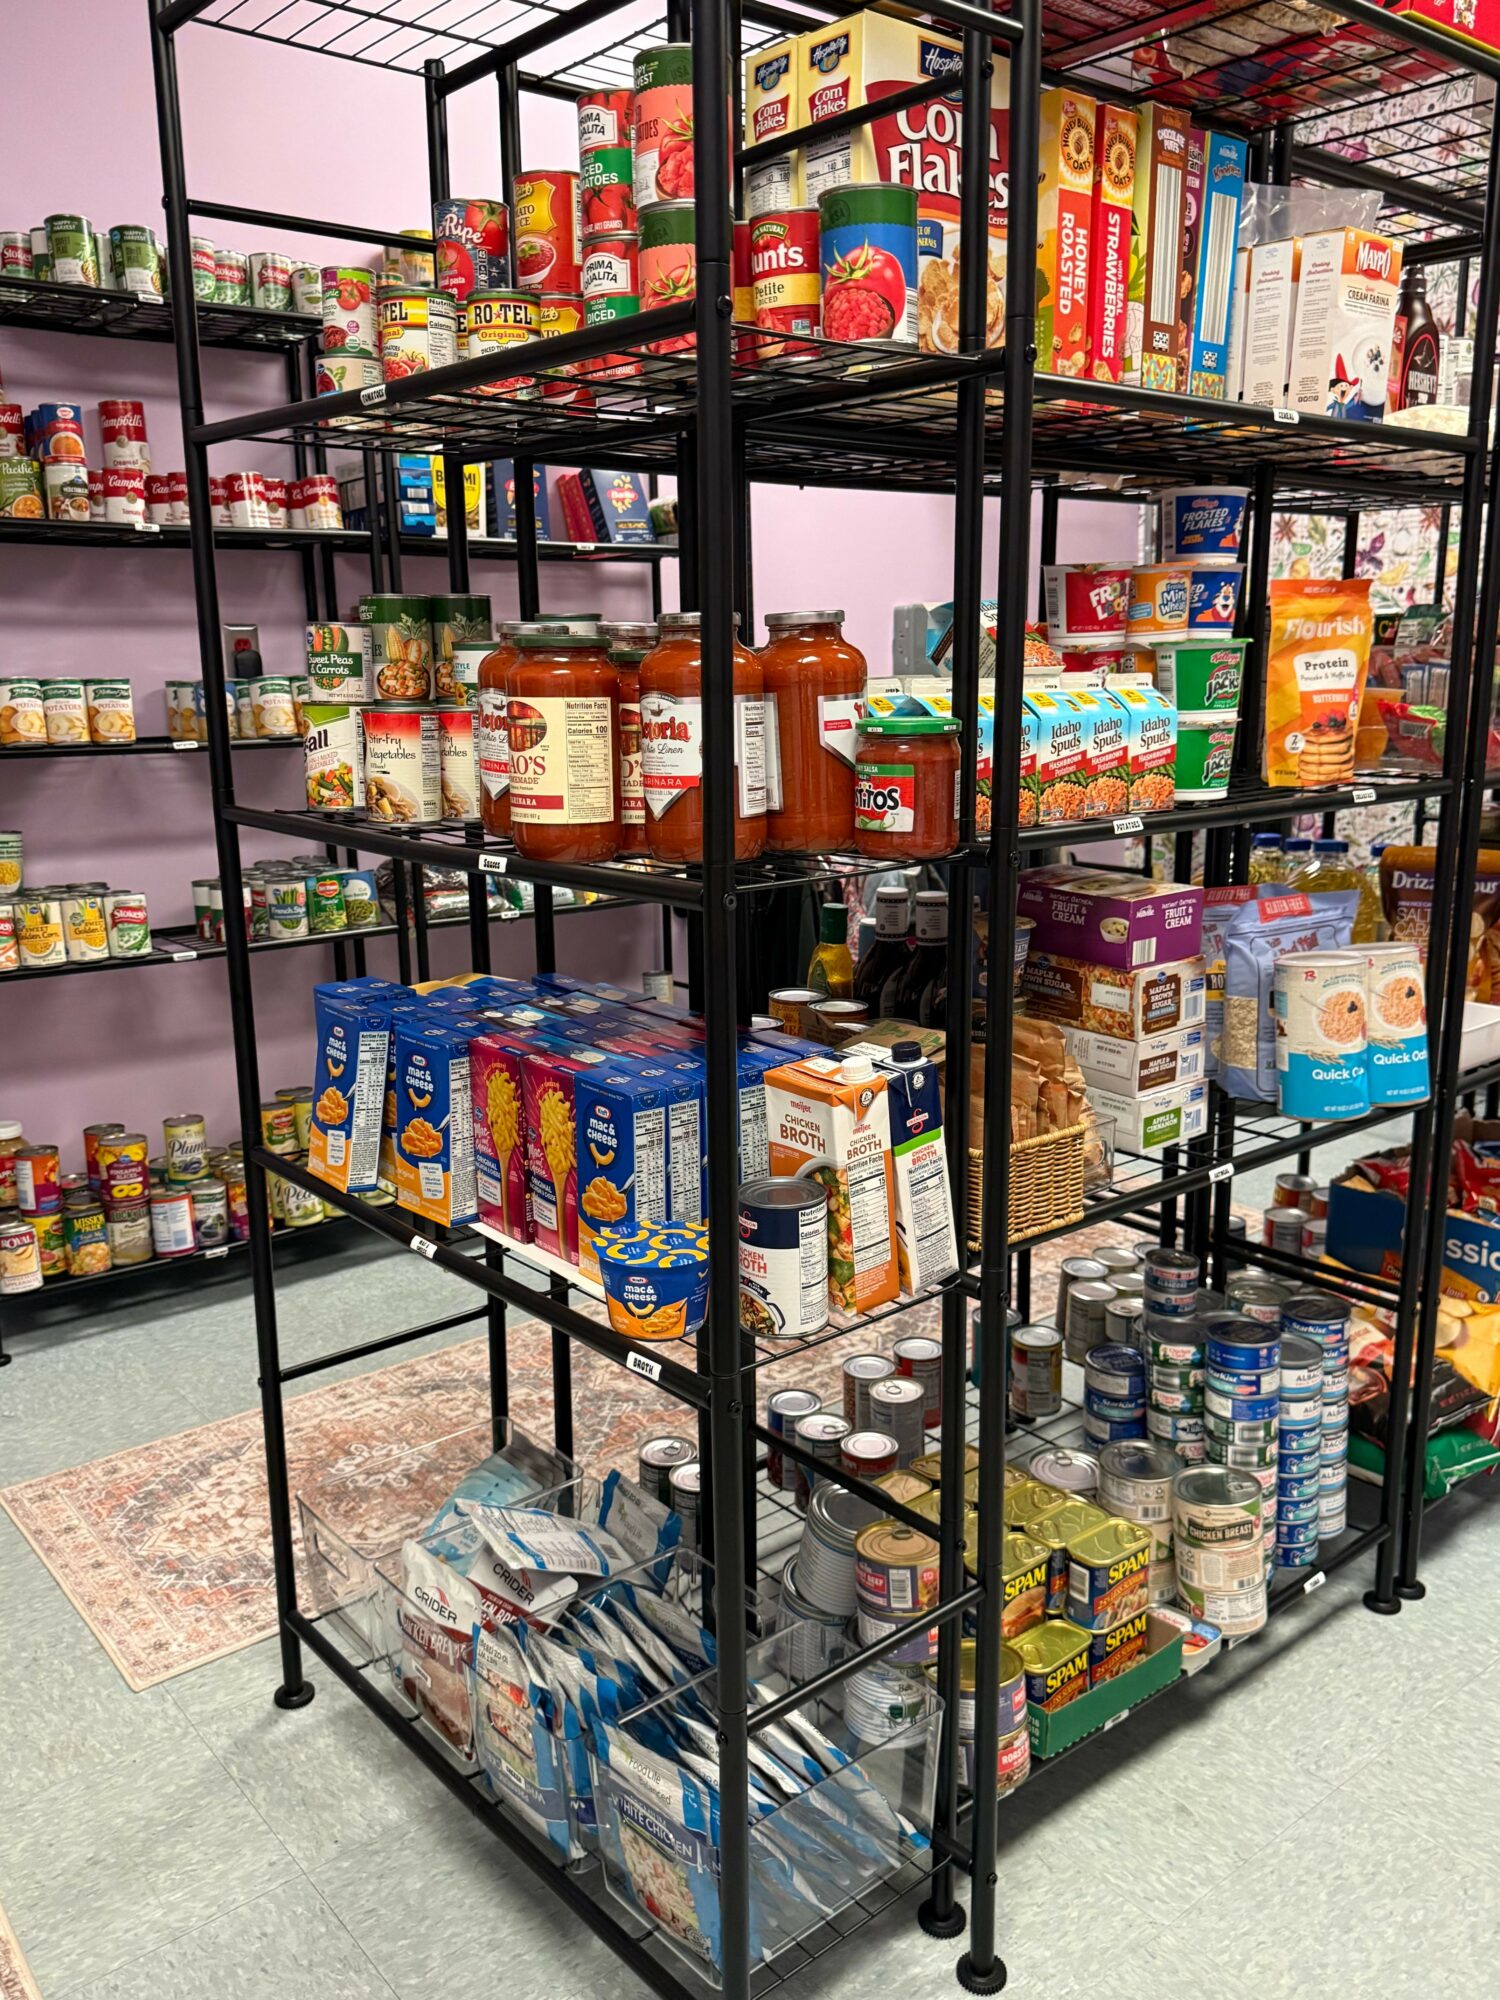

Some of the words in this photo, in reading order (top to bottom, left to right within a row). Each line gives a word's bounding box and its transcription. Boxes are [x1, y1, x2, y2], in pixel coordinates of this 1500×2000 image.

[925, 48, 962, 75] Hospita
[815, 87, 842, 105] Corn
[758, 103, 781, 121] Corn
[813, 98, 846, 122] Flakes
[756, 115, 785, 136] Flakes
[1063, 119, 1076, 147] HONEY
[1077, 119, 1093, 153] BUNCHES
[1158, 129, 1185, 148] CHOCOLATE
[1106, 136, 1117, 162] HONEY
[1119, 135, 1134, 169] BUNCHES
[1073, 160, 1090, 170] OATS
[1114, 175, 1130, 185] OATS
[445, 214, 483, 243] Ripe
[586, 261, 612, 274] PRIMA
[1060, 213, 1074, 315] ROASTED
[1075, 228, 1088, 305] HONEY
[1357, 242, 1391, 279] MAYPO
[755, 283, 784, 298] Petite
[1102, 213, 1120, 358] STRAWBERRIES
[1116, 281, 1124, 314] REAL
[1348, 290, 1367, 302] CREAM
[1369, 293, 1389, 307] FARINA
[587, 309, 616, 323] DICED
[481, 331, 526, 339] Original
[362, 388, 384, 403] TOMATOES
[2, 463, 33, 474] Pacific
[1182, 510, 1228, 523] FROSTED
[1185, 519, 1224, 531] FLAKES
[1285, 617, 1364, 640] Flourish
[309, 654, 330, 664] Sweet
[331, 654, 353, 664] Peas
[1305, 659, 1348, 670] Protein
[316, 664, 350, 674] Carrots
[1205, 678, 1239, 706] JACKS
[567, 702, 592, 711] Nutrition
[593, 702, 608, 710] Facts
[1051, 721, 1081, 739] Idaho
[1094, 718, 1122, 735] Idaho
[1141, 716, 1170, 733] Idaho
[369, 734, 401, 749] Stir-Fry
[1051, 734, 1081, 756] Spuds
[1093, 730, 1122, 751] Spuds
[1140, 729, 1170, 749] Spuds
[658, 742, 684, 754] Linen
[1139, 748, 1171, 761] HASHBROWN
[370, 750, 416, 763] Vegetables
[1049, 755, 1082, 770] HASHBROWN
[1092, 751, 1123, 764] HASHBROWN
[1145, 759, 1165, 769] Potatoes
[511, 756, 545, 776] AO'S
[1055, 765, 1076, 777] Potatoes
[1098, 761, 1118, 772] Potatoes
[1116, 821, 1140, 831] POTATOES
[484, 859, 500, 869] Sauces
[1208, 889, 1233, 900] GLUTEN
[1235, 888, 1251, 900] FREE
[1052, 901, 1078, 913] FRUIT
[1265, 900, 1288, 914] GLUTEN
[1289, 897, 1304, 910] FREE
[1052, 910, 1085, 925] CREAM
[1165, 908, 1186, 919] FRUIT
[1165, 917, 1191, 929] CREAM
[1027, 967, 1053, 977] MAPLE
[1150, 986, 1169, 994] MAPLE
[1151, 991, 1173, 1001] BROWN
[1152, 1000, 1172, 1009] SUGAR
[329, 1037, 339, 1049] mac
[1149, 1059, 1164, 1067] MAPLE
[1373, 1052, 1410, 1066] Quick
[408, 1066, 424, 1078] mac
[425, 1071, 431, 1081] &
[1140, 1066, 1159, 1076] BROWN
[1160, 1061, 1176, 1071] SUGAR
[1313, 1068, 1349, 1081] Quick
[791, 1101, 812, 1113] meijer
[590, 1118, 608, 1131] mac
[609, 1124, 615, 1135] &
[785, 1114, 820, 1133] CHICKEN
[1147, 1118, 1177, 1133] CINNAMON
[1152, 1116, 1169, 1124] APPLE
[853, 1124, 871, 1135] meijer
[780, 1124, 825, 1153] BROTH
[850, 1134, 876, 1147] CHICKEN
[847, 1140, 882, 1160] BROTH
[912, 1144, 934, 1157] CHICKEN
[912, 1150, 937, 1165] BROTH
[477, 1155, 497, 1170] ORIGINAL
[848, 1159, 867, 1172] Nutrition
[868, 1155, 883, 1164] Facts
[909, 1163, 929, 1174] Nutrition
[930, 1157, 942, 1166] Facts
[531, 1175, 552, 1193] ORIGINAL
[879, 1177, 885, 1185] 15
[850, 1187, 865, 1195] Calories
[912, 1185, 928, 1194] Calories
[801, 1229, 819, 1237] Calories
[625, 1285, 645, 1293] mac
[633, 1358, 653, 1375] BROTH
[1190, 1526, 1222, 1540] CHICKEN
[1225, 1524, 1252, 1536] BREAST
[1109, 1549, 1149, 1585] SPAM
[493, 1563, 535, 1606] CRIDER
[1004, 1564, 1046, 1599] SPAM
[415, 1587, 458, 1624] CRIDER
[1106, 1614, 1146, 1650] SPAM
[1046, 1652, 1088, 1693] SPAM
